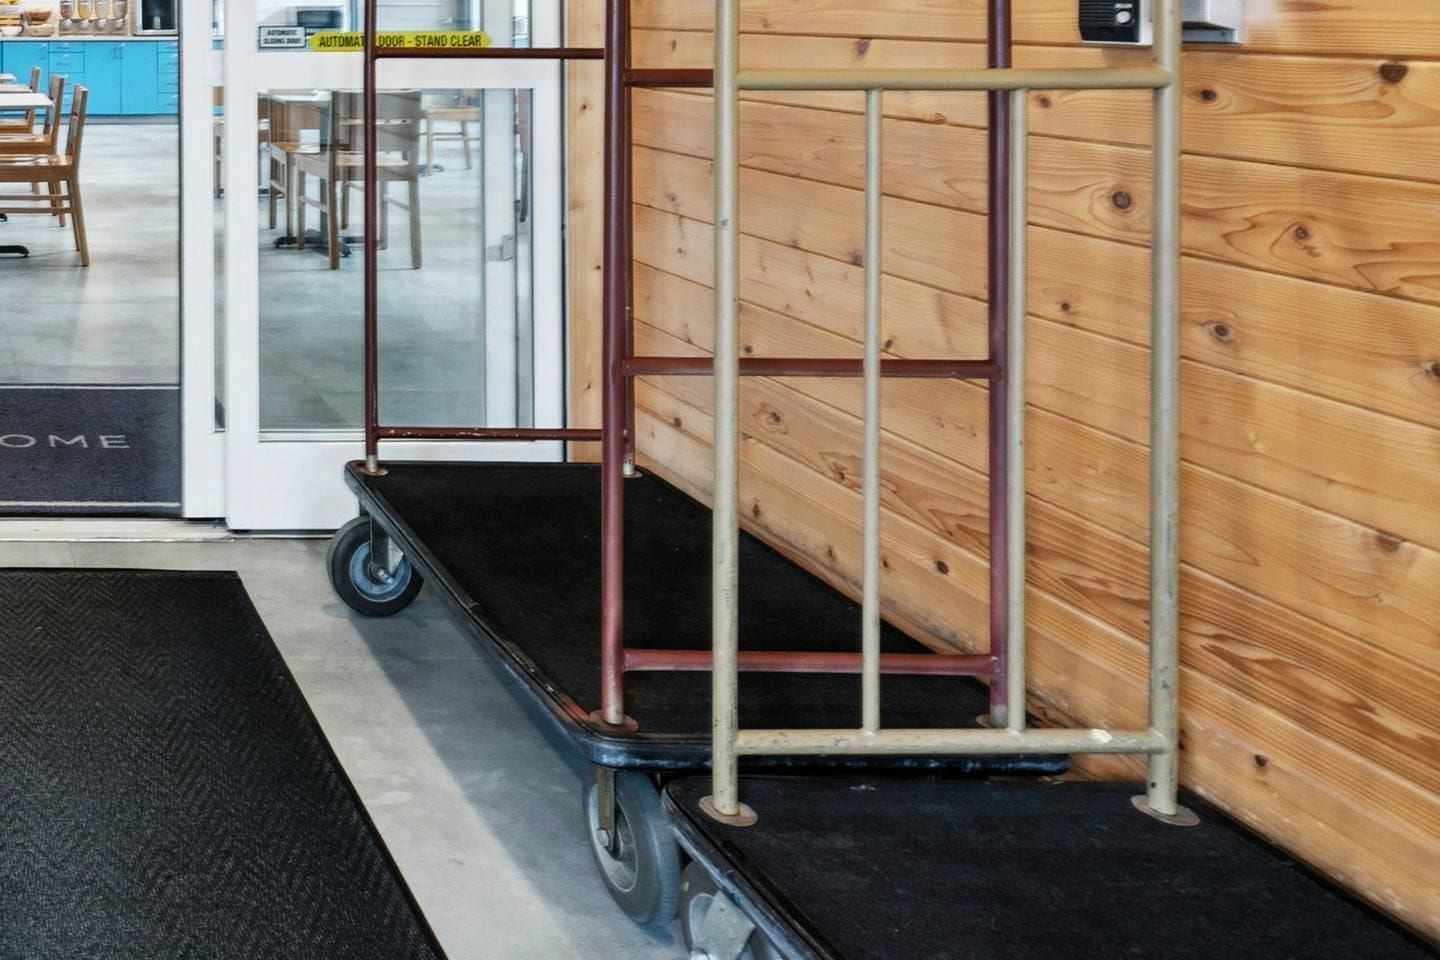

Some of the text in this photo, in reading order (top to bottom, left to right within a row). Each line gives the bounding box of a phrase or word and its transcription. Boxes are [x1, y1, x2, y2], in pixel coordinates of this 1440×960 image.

[319, 35, 366, 48] AUTOMAT
[378, 35, 406, 48] DOOR
[415, 35, 448, 47] STAND
[450, 35, 482, 47] CLEAR
